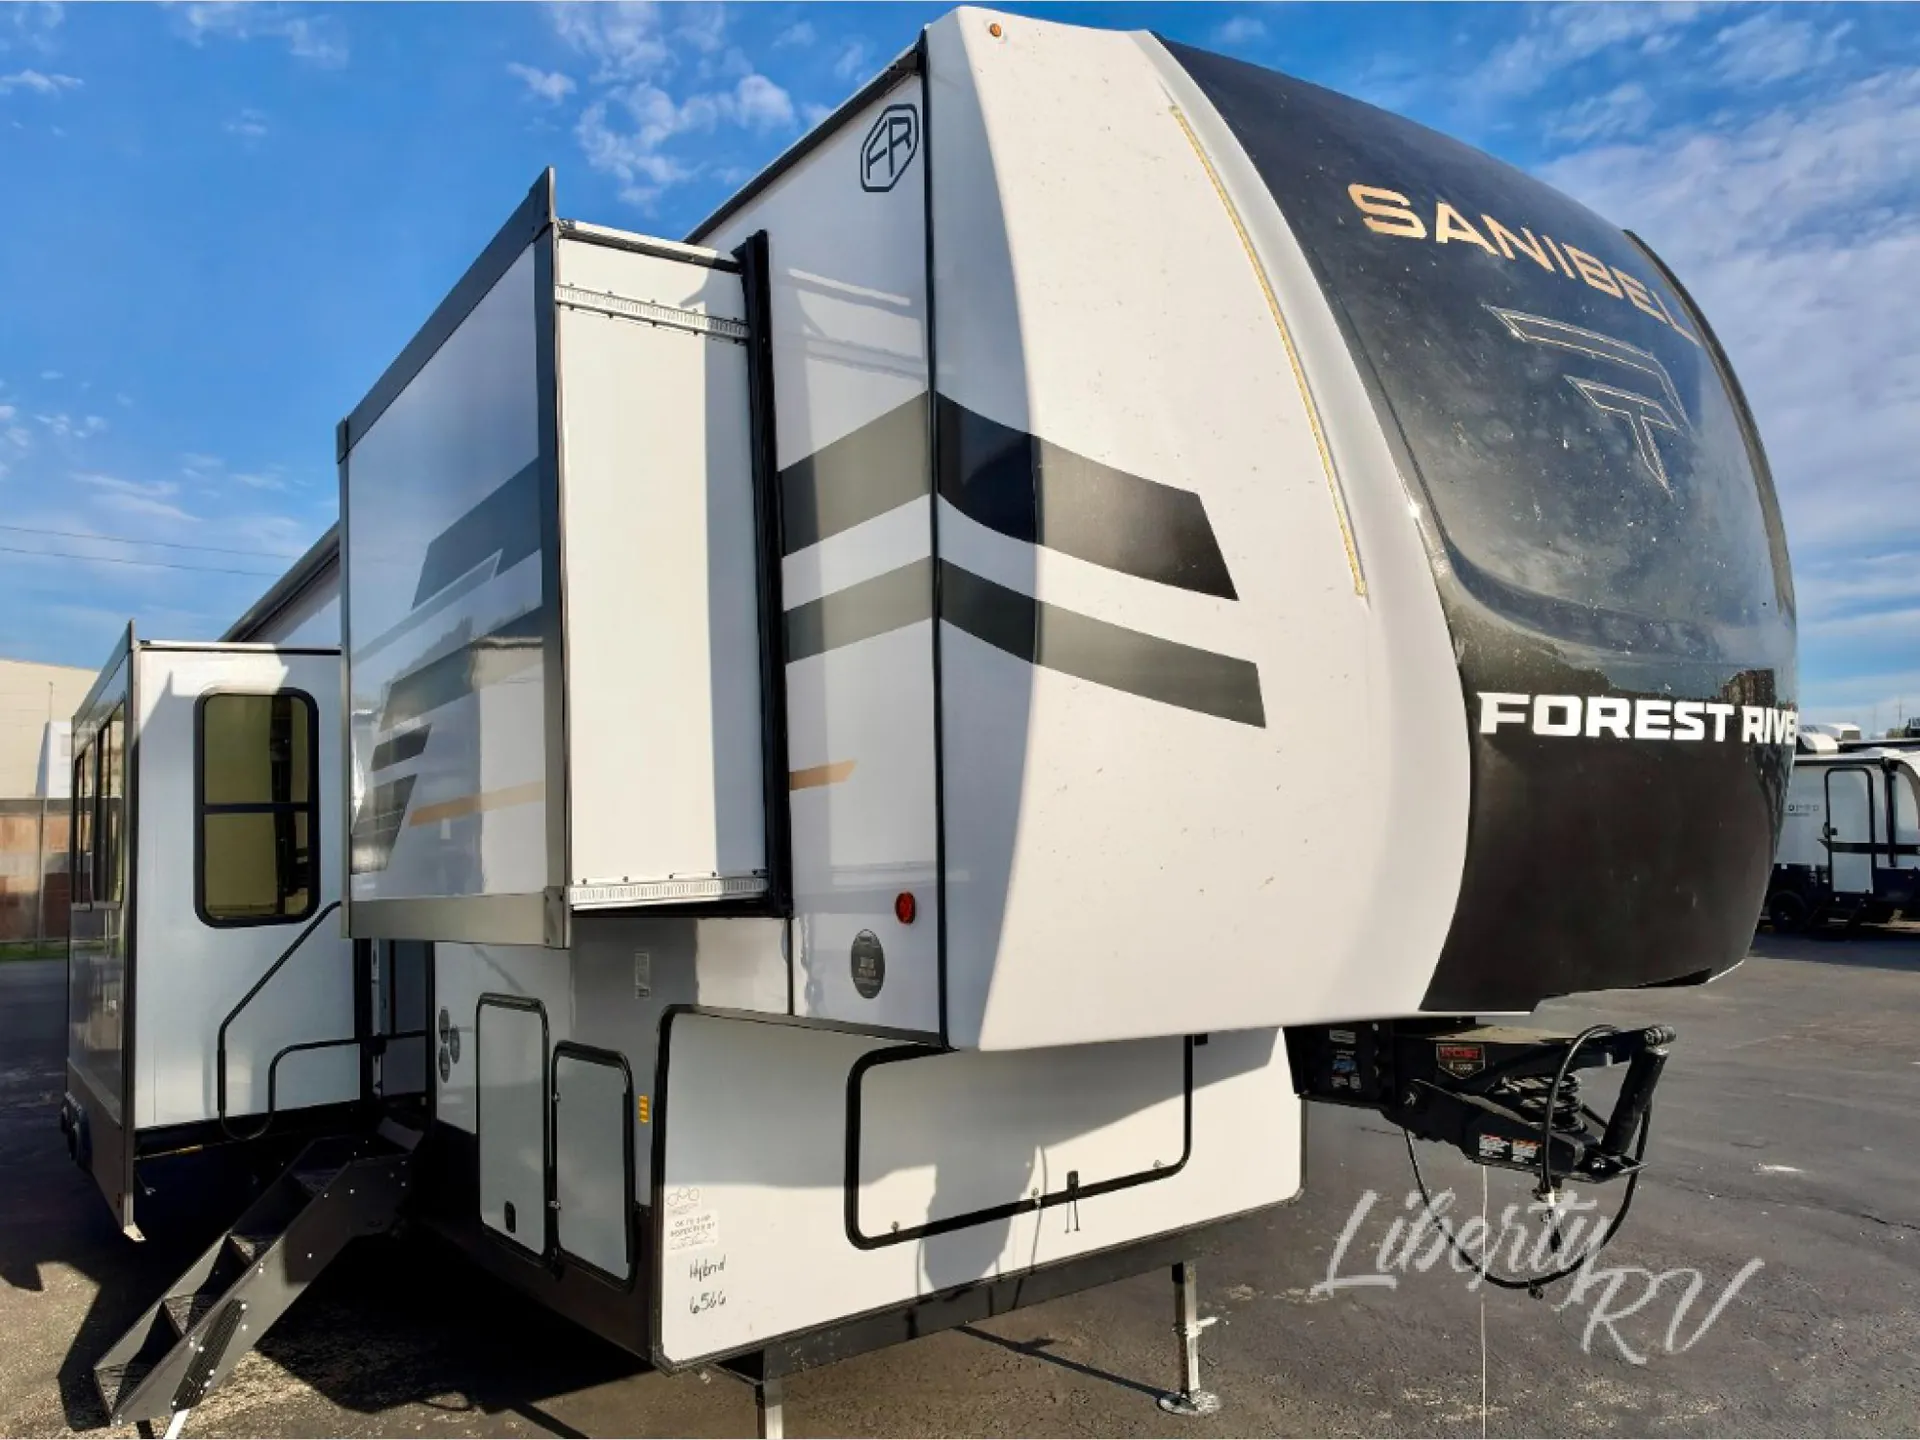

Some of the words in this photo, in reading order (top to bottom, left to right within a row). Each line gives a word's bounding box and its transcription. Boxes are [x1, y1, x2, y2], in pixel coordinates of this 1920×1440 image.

[1347, 183, 1702, 348] SANIBEL
[1476, 691, 1735, 743] FOREST
[1741, 705, 1799, 745] RIVE
